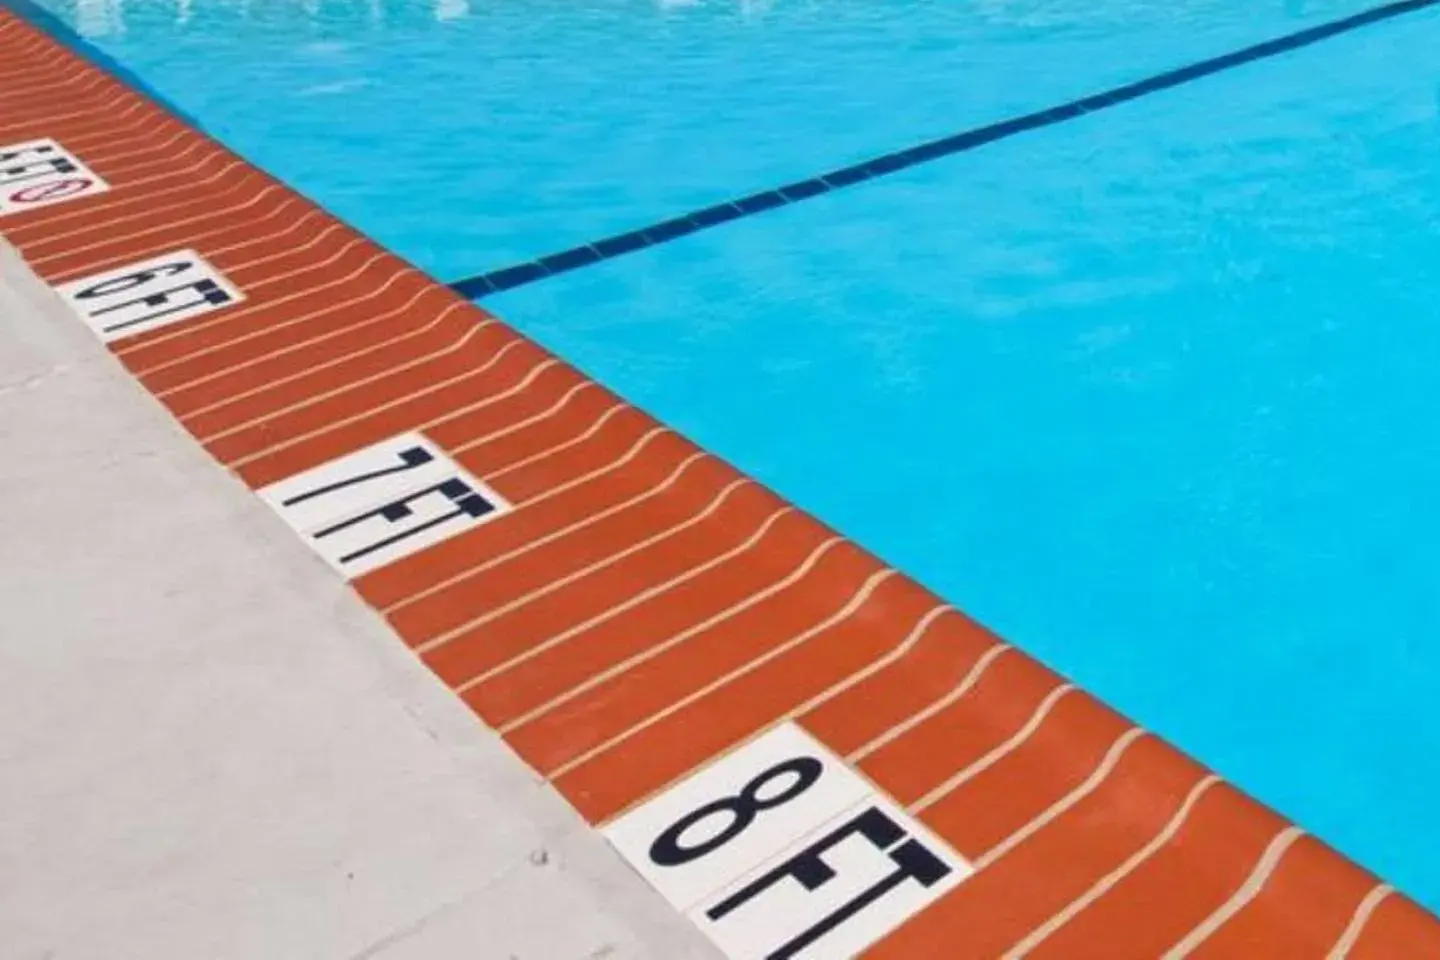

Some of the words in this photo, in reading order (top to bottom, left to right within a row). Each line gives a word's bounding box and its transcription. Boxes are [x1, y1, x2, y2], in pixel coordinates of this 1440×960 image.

[74, 260, 194, 299] 6
[89, 278, 231, 329] FT
[282, 446, 435, 507] 7
[312, 477, 496, 564] FT
[648, 756, 824, 867] 8
[706, 805, 954, 960] FT
